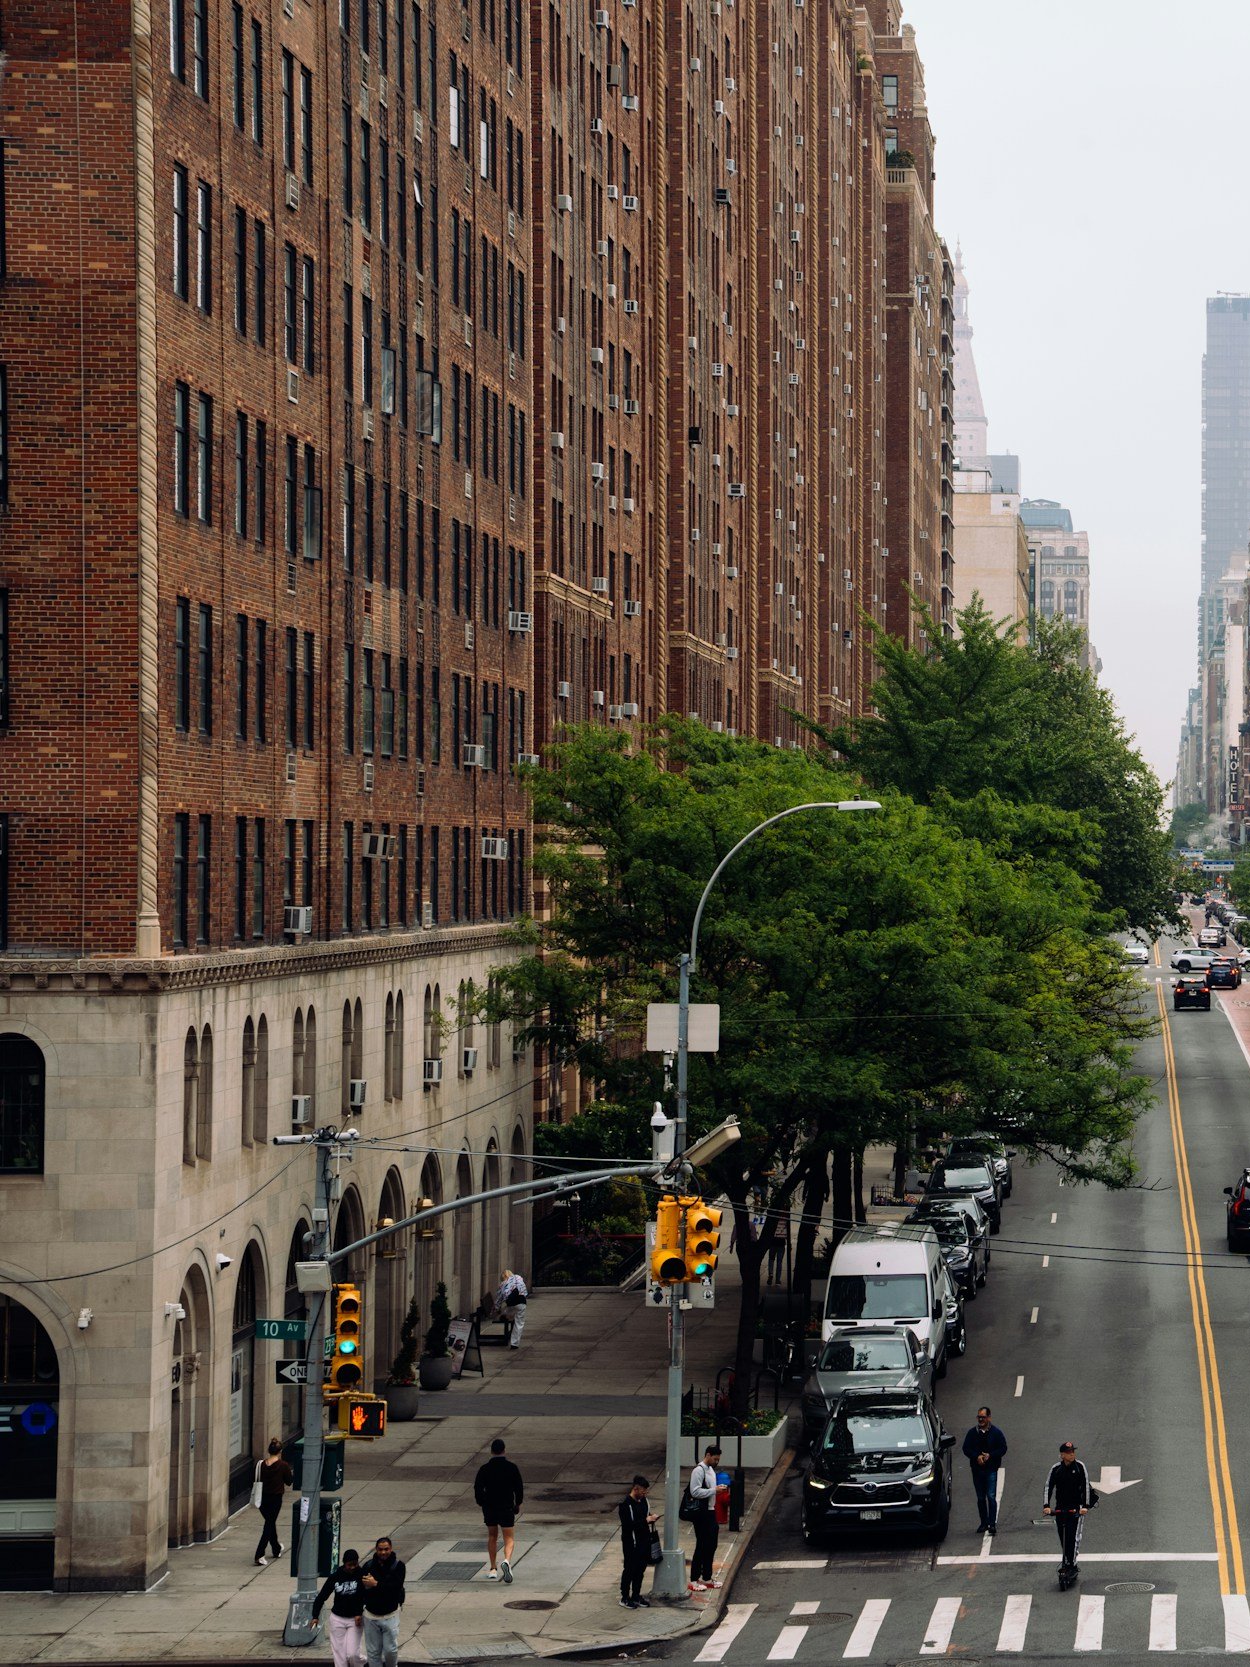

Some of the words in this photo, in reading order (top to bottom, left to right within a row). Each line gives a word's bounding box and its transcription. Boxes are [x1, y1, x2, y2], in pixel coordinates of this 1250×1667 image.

[1230, 750, 1238, 804] HOTEL
[262, 1321, 279, 1337] 10
[287, 1323, 299, 1332] Av
